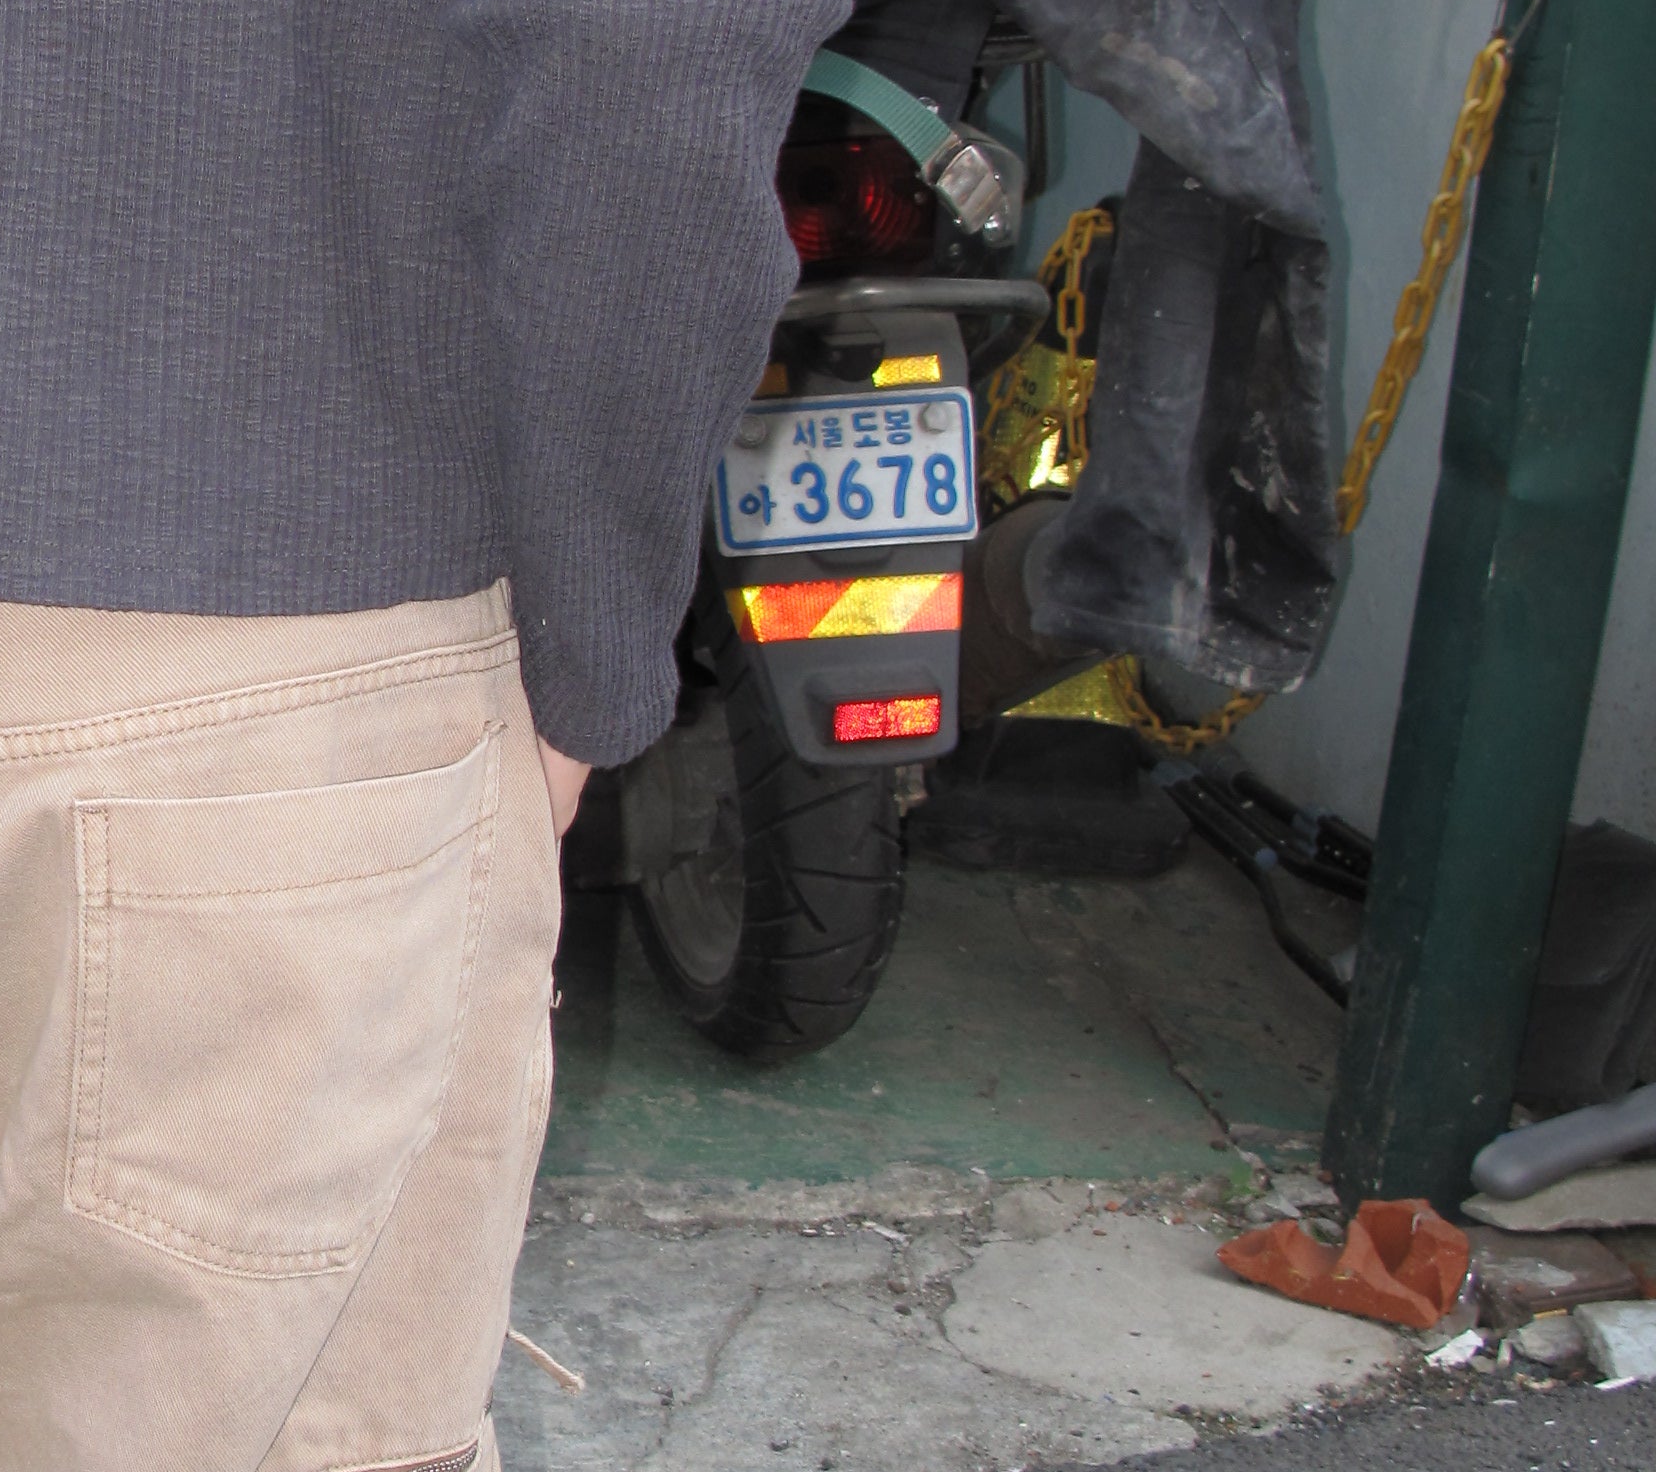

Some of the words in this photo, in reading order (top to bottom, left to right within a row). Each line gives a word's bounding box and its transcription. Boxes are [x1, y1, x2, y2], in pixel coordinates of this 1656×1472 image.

[793, 415, 844, 449] 서울
[852, 409, 913, 450] 도봉
[738, 484, 776, 526] 아
[790, 452, 960, 525] 3678
